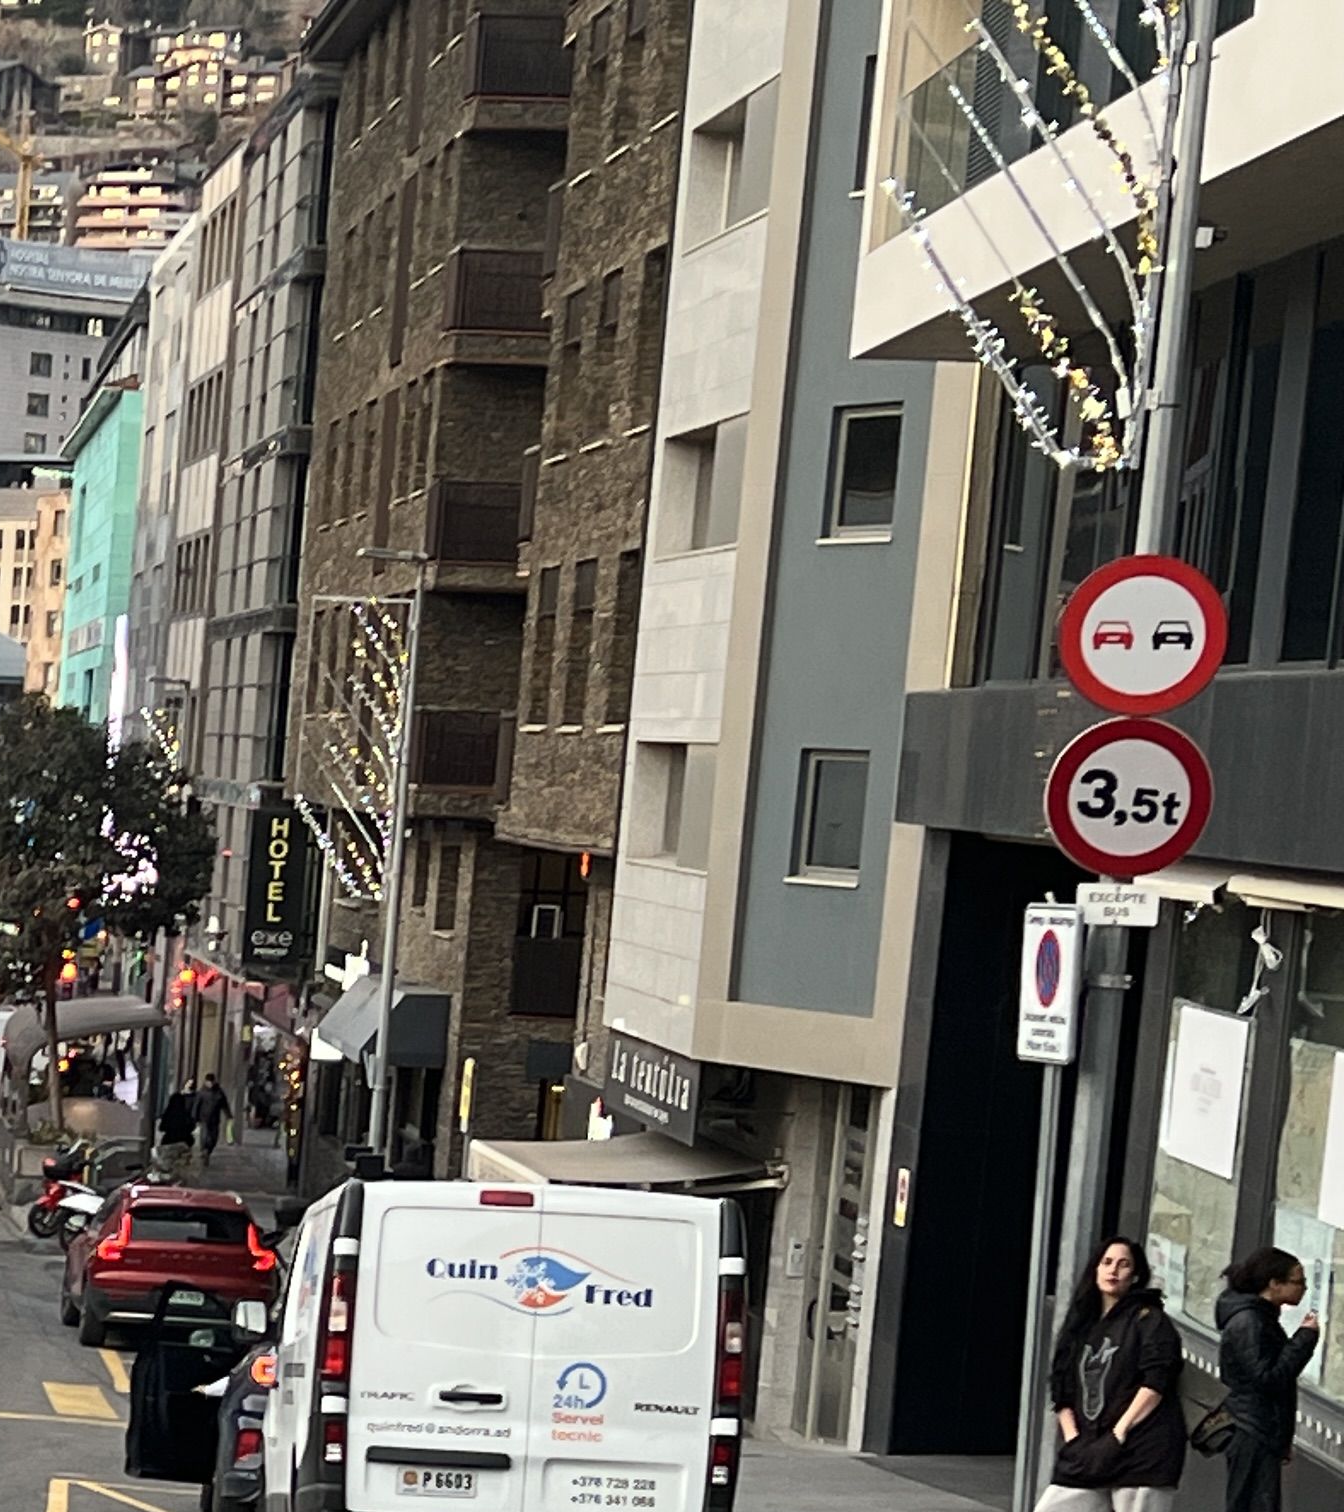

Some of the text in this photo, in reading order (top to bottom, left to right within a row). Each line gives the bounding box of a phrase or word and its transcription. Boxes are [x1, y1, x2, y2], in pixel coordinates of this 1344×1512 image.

[1077, 768, 1181, 826] 3,5t
[266, 817, 291, 922] HOTEL
[1088, 891, 1147, 905] EXCEPTE
[1103, 906, 1130, 918] BUS
[251, 930, 294, 948] exe
[425, 1258, 499, 1281] Quin
[584, 1284, 653, 1308] Fred
[552, 1393, 586, 1410] 24h
[633, 1402, 701, 1416] RENAULT
[551, 1411, 605, 1425] Servei
[422, 1471, 433, 1489] P
